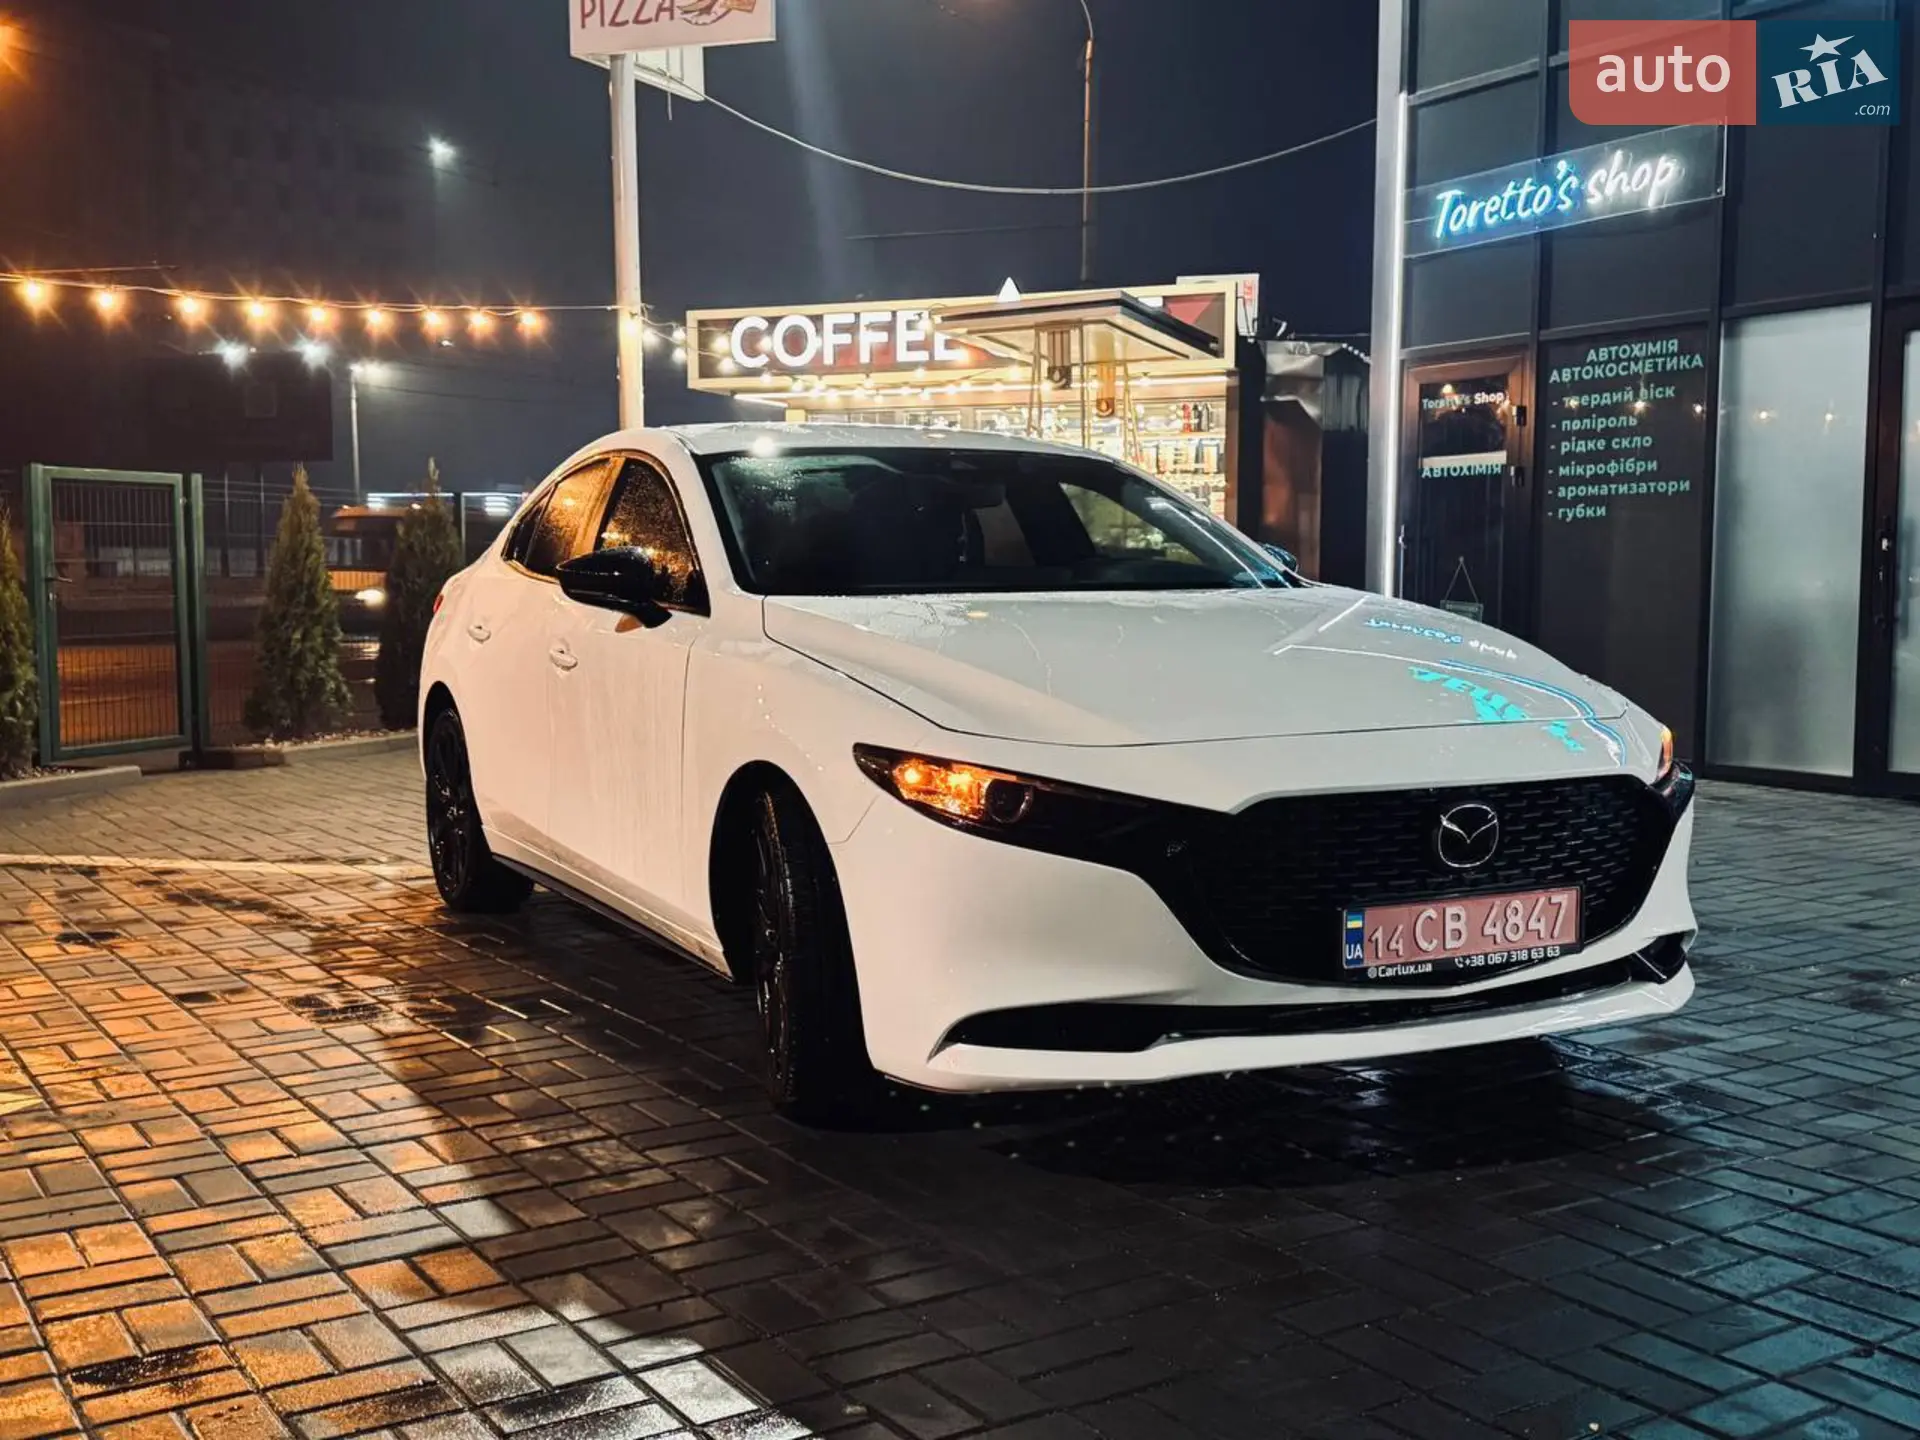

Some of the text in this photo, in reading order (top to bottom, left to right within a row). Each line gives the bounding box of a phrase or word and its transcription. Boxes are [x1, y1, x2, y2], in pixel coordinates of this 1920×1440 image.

[580, 0, 675, 29] PIZZA
[1434, 149, 1680, 238] Toretto's shop
[1586, 339, 1679, 363] АВТОХІМІЯ
[1549, 353, 1704, 384] АВТОКОСМЕТИКА
[1561, 413, 1638, 433] поліроль
[1560, 435, 1653, 455] рідке скло
[1421, 463, 1502, 479] АВТОХІМІЯ
[1558, 458, 1658, 478] мікрофібри
[1557, 479, 1691, 500] ароматизатори
[1557, 503, 1606, 522] губки
[1369, 924, 1405, 959] 14
[1481, 894, 1569, 945] 4847
[1346, 945, 1363, 960] UA
[1487, 953, 1508, 965] 067
[1509, 951, 1528, 962] 318
[1547, 946, 1561, 957] 63
